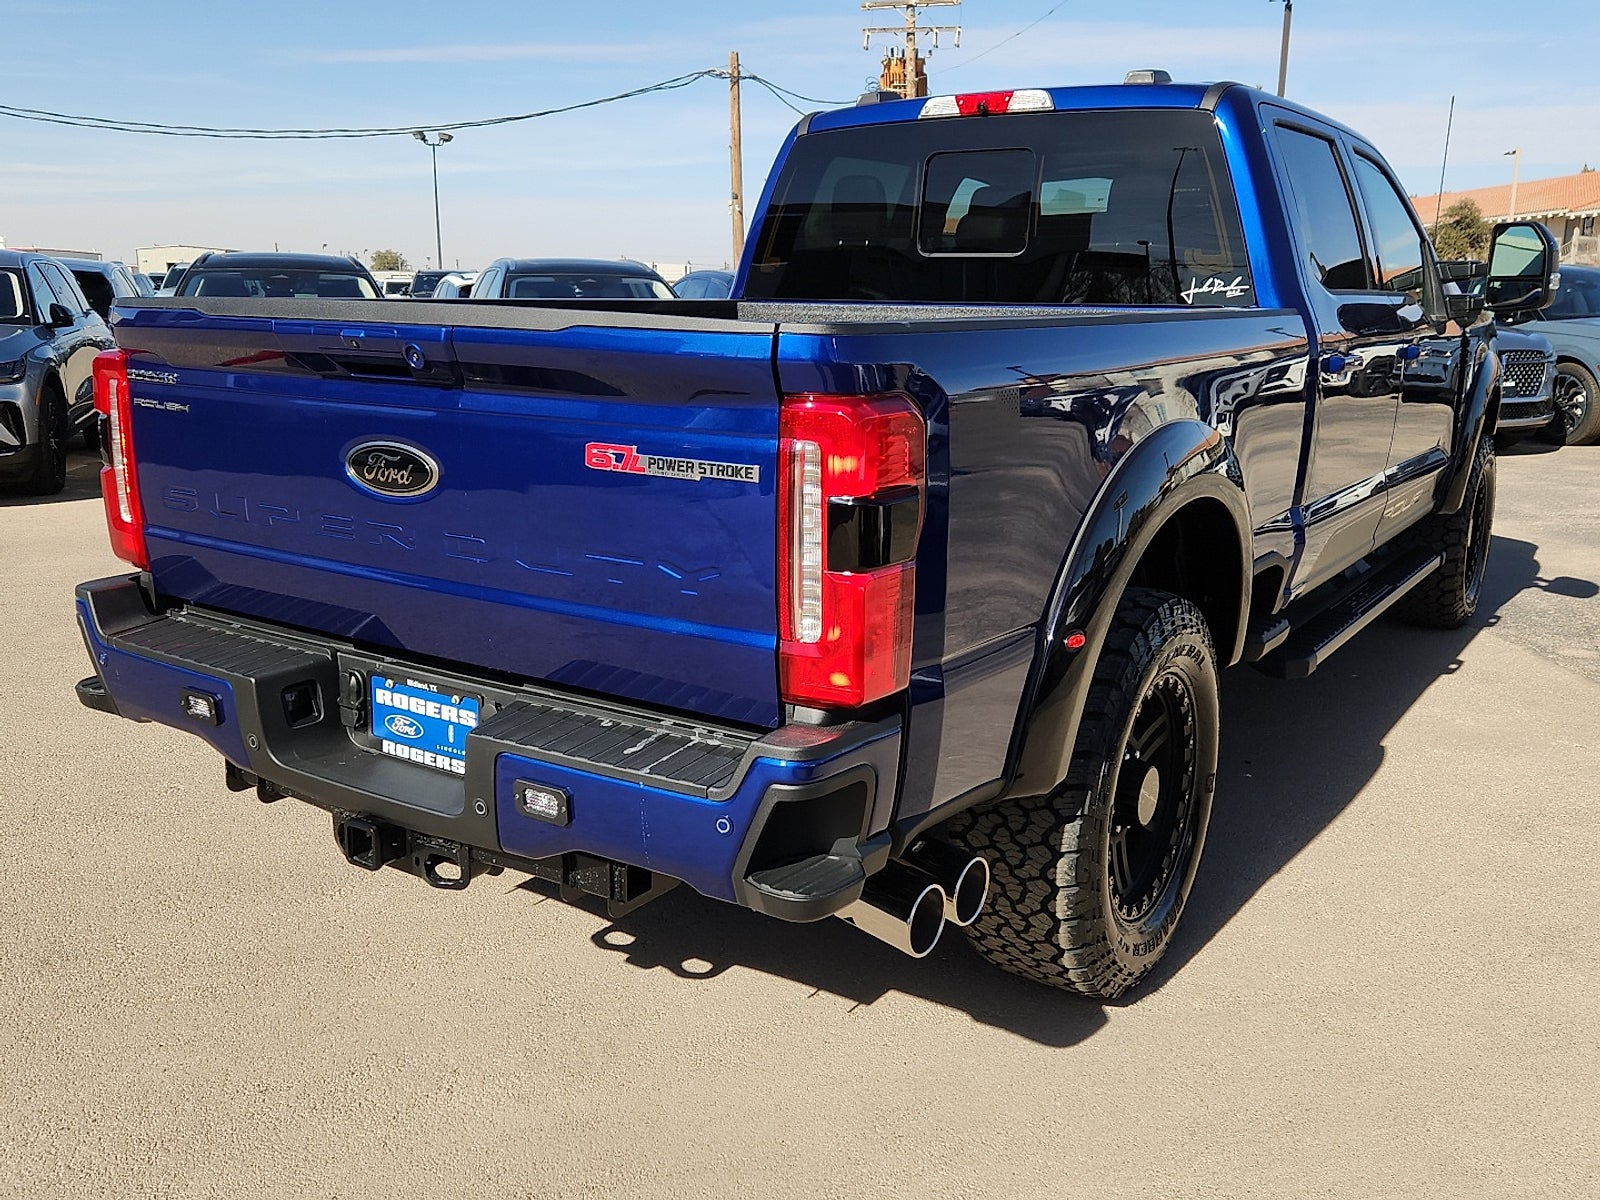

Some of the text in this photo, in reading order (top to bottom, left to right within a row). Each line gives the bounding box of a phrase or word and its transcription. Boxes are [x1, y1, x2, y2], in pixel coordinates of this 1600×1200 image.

[133, 397, 190, 413] ROUSH
[362, 451, 413, 485] Ford
[585, 441, 754, 480] 6.7L POWER STROKE
[163, 486, 723, 597] SUPER DUTY
[375, 687, 478, 729] ROGERS
[391, 716, 416, 736] Ford
[382, 739, 466, 775] ROGERS
